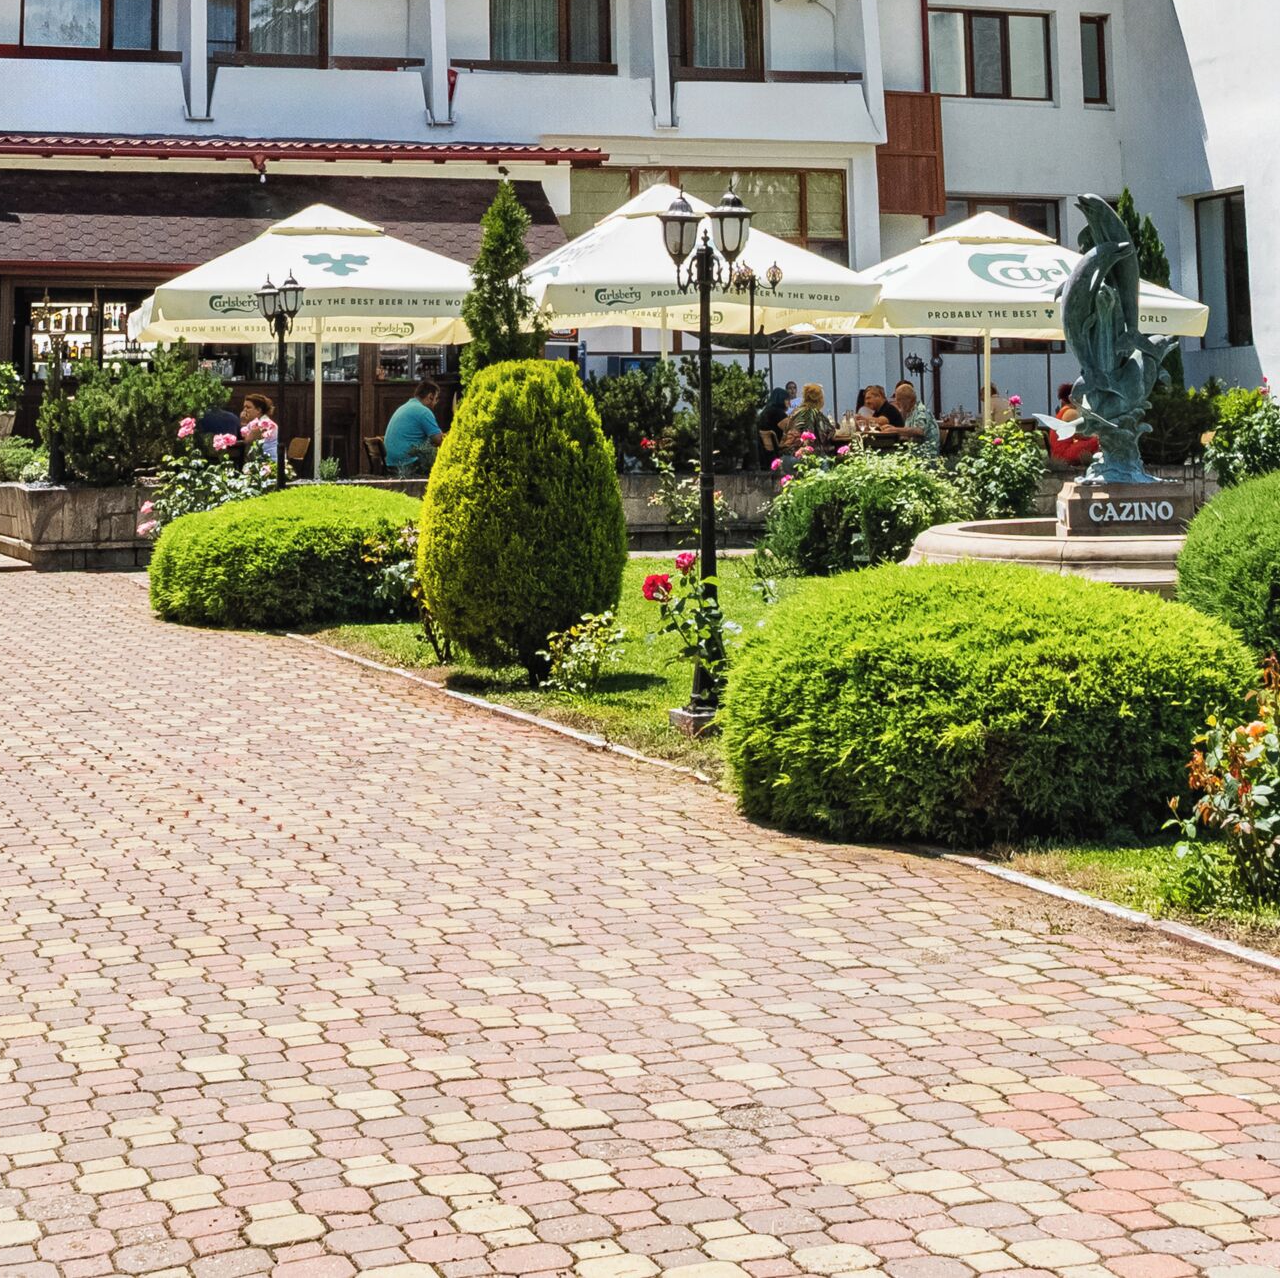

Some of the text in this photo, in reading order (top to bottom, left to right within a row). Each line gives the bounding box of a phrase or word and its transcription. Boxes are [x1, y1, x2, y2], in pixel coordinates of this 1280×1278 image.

[594, 286, 642, 306] Carlsberg
[788, 292, 805, 300] THE
[808, 293, 841, 302] WORLD
[209, 294, 260, 314] Carlsberg
[327, 297, 346, 306] THE
[350, 298, 374, 306] BEST
[378, 298, 403, 306] BEER
[407, 298, 418, 306] IN
[928, 309, 1038, 319] PROBABLY THE BEST
[1140, 314, 1168, 323] ORLD
[1088, 501, 1174, 522] CAZINO
